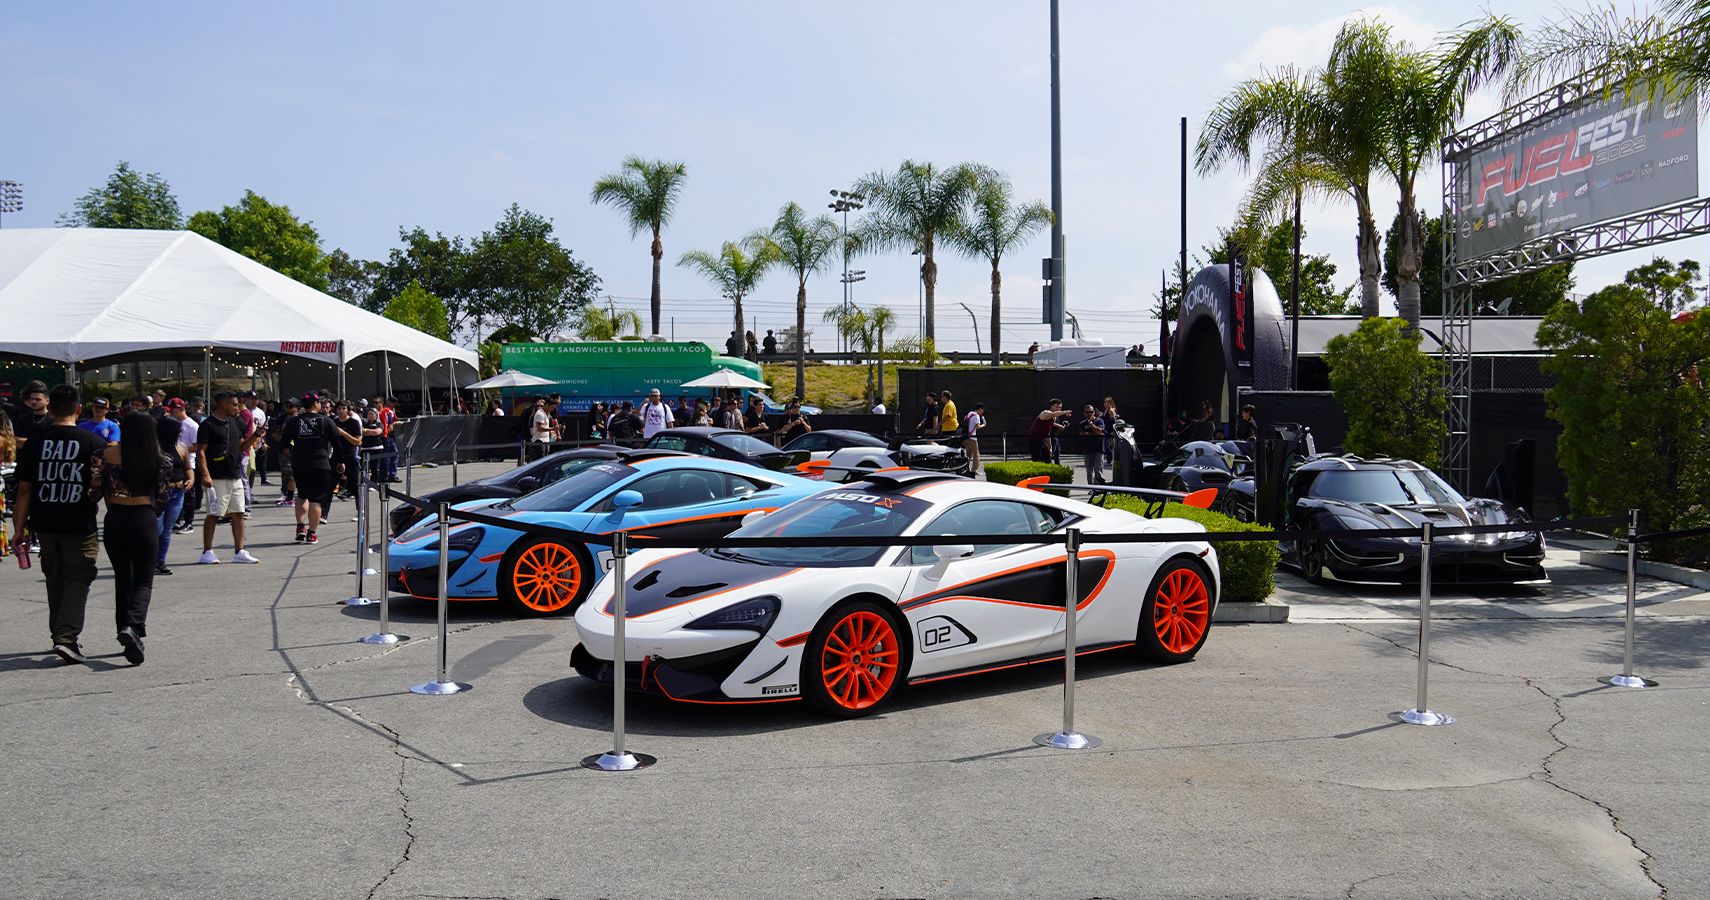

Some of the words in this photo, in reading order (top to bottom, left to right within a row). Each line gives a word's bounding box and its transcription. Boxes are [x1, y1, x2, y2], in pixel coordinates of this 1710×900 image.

[1596, 135, 1647, 165] 2022
[1184, 284, 1225, 343] YOKOHAMA
[280, 341, 338, 353] MOTORTREND
[505, 346, 526, 354] BEST
[529, 346, 555, 354] TASTY
[557, 345, 614, 353] SANDWICHES
[41, 439, 80, 460] BAD
[38, 461, 84, 482] LUCK
[38, 483, 84, 503] CLUB
[924, 625, 951, 647] 02
[761, 683, 797, 695] PIRELLI
